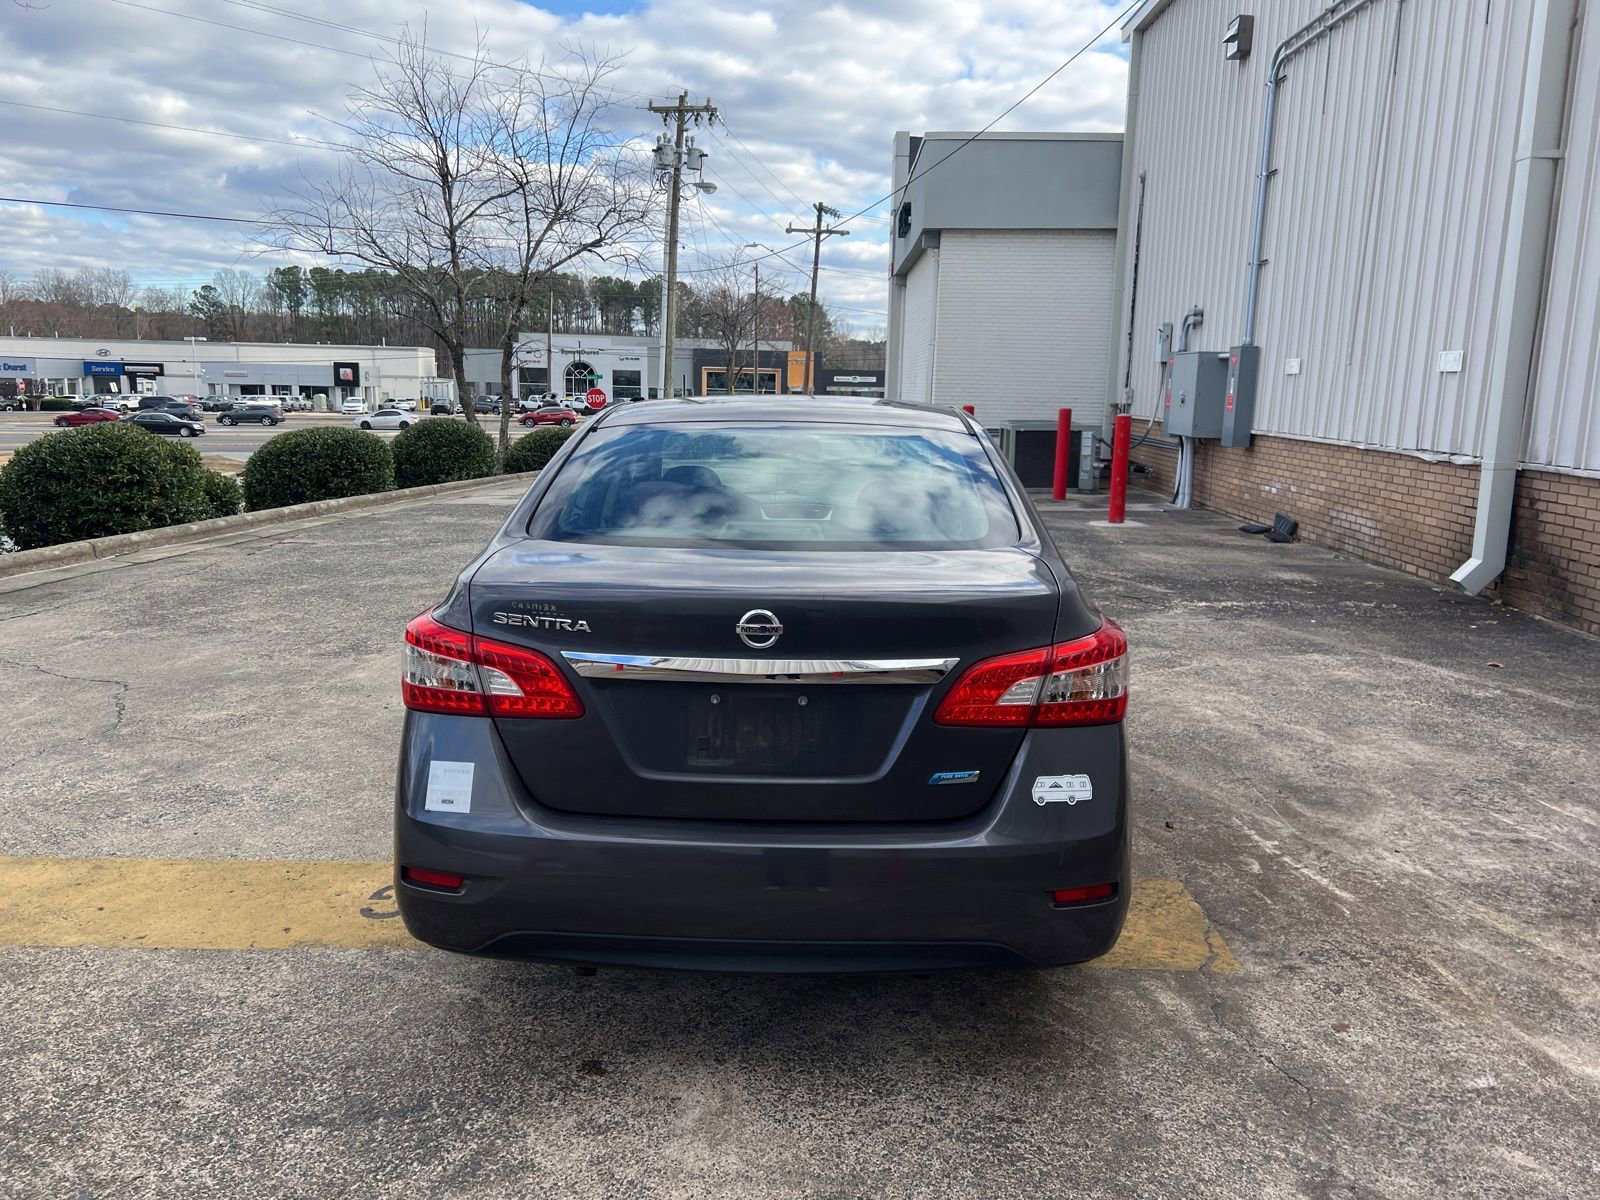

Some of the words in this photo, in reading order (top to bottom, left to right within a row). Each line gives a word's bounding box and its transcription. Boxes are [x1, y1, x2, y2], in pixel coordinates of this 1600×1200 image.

[3, 362, 27, 371] Durst
[587, 394, 605, 404] STOP
[493, 611, 592, 633] SENTRA
[740, 625, 779, 633] NISSAN
